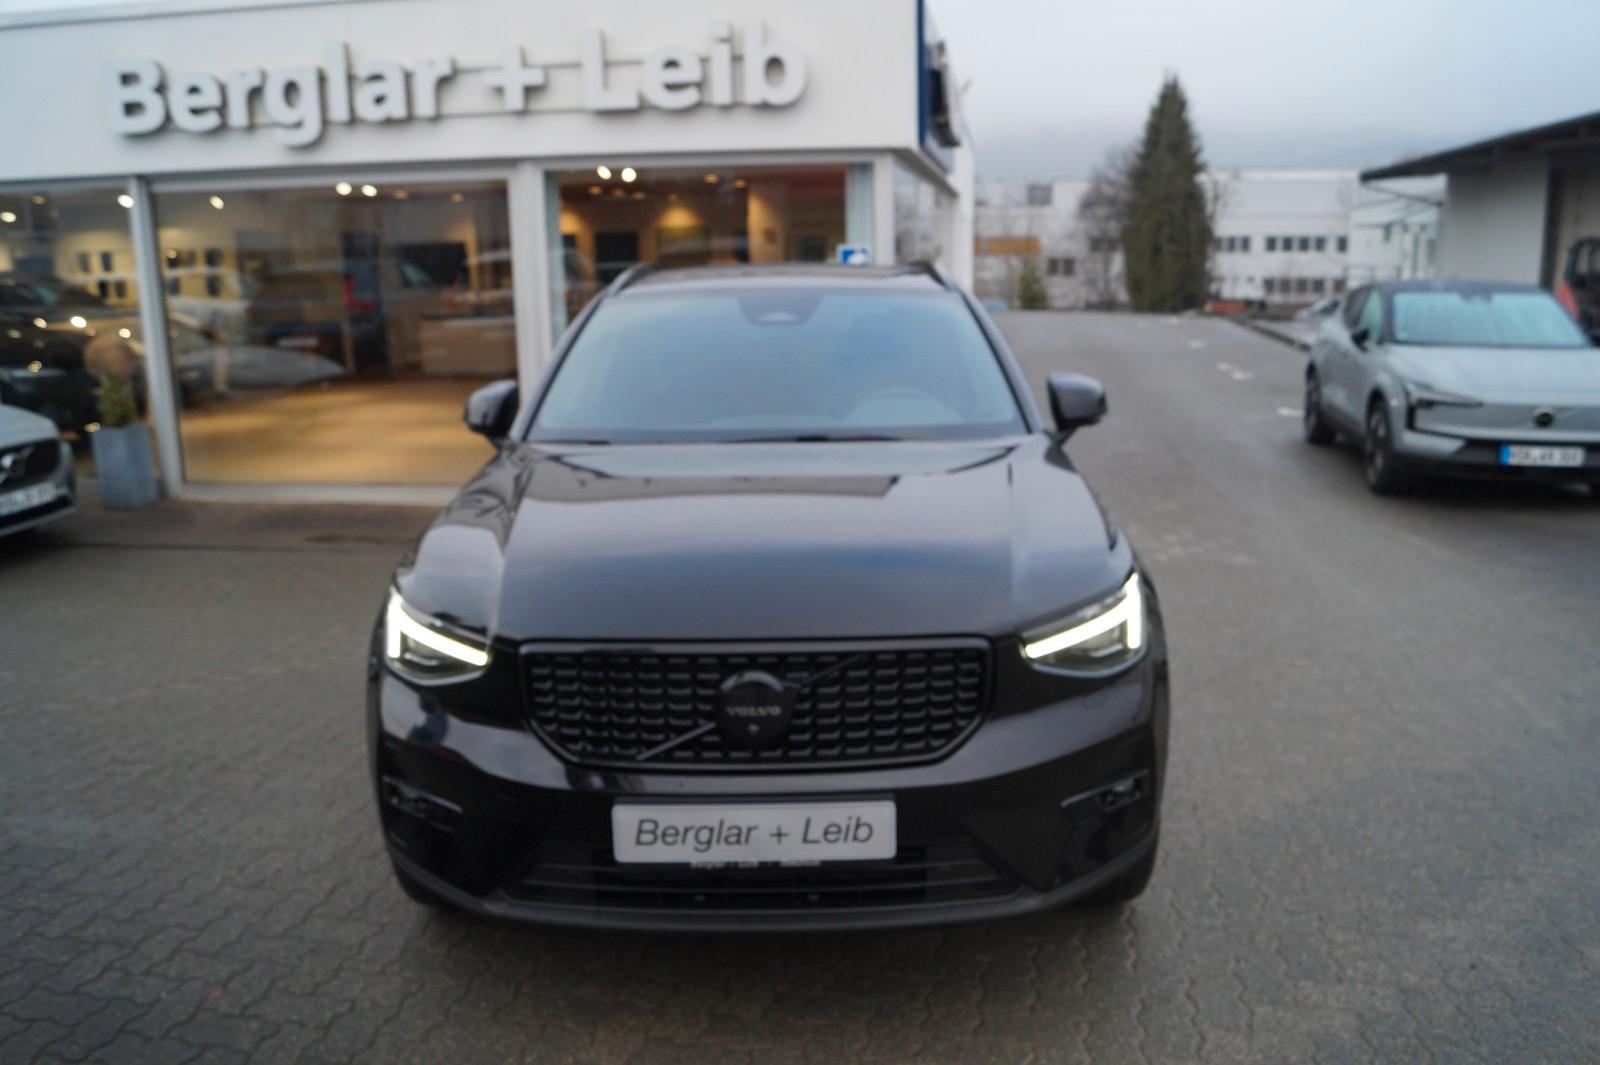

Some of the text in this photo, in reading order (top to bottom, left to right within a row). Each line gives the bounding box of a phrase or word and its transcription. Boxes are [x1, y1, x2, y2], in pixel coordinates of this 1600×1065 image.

[108, 22, 808, 148] Berglar + Leib
[725, 705, 782, 717] VOLVO
[634, 815, 874, 853] Berglar + Leib
